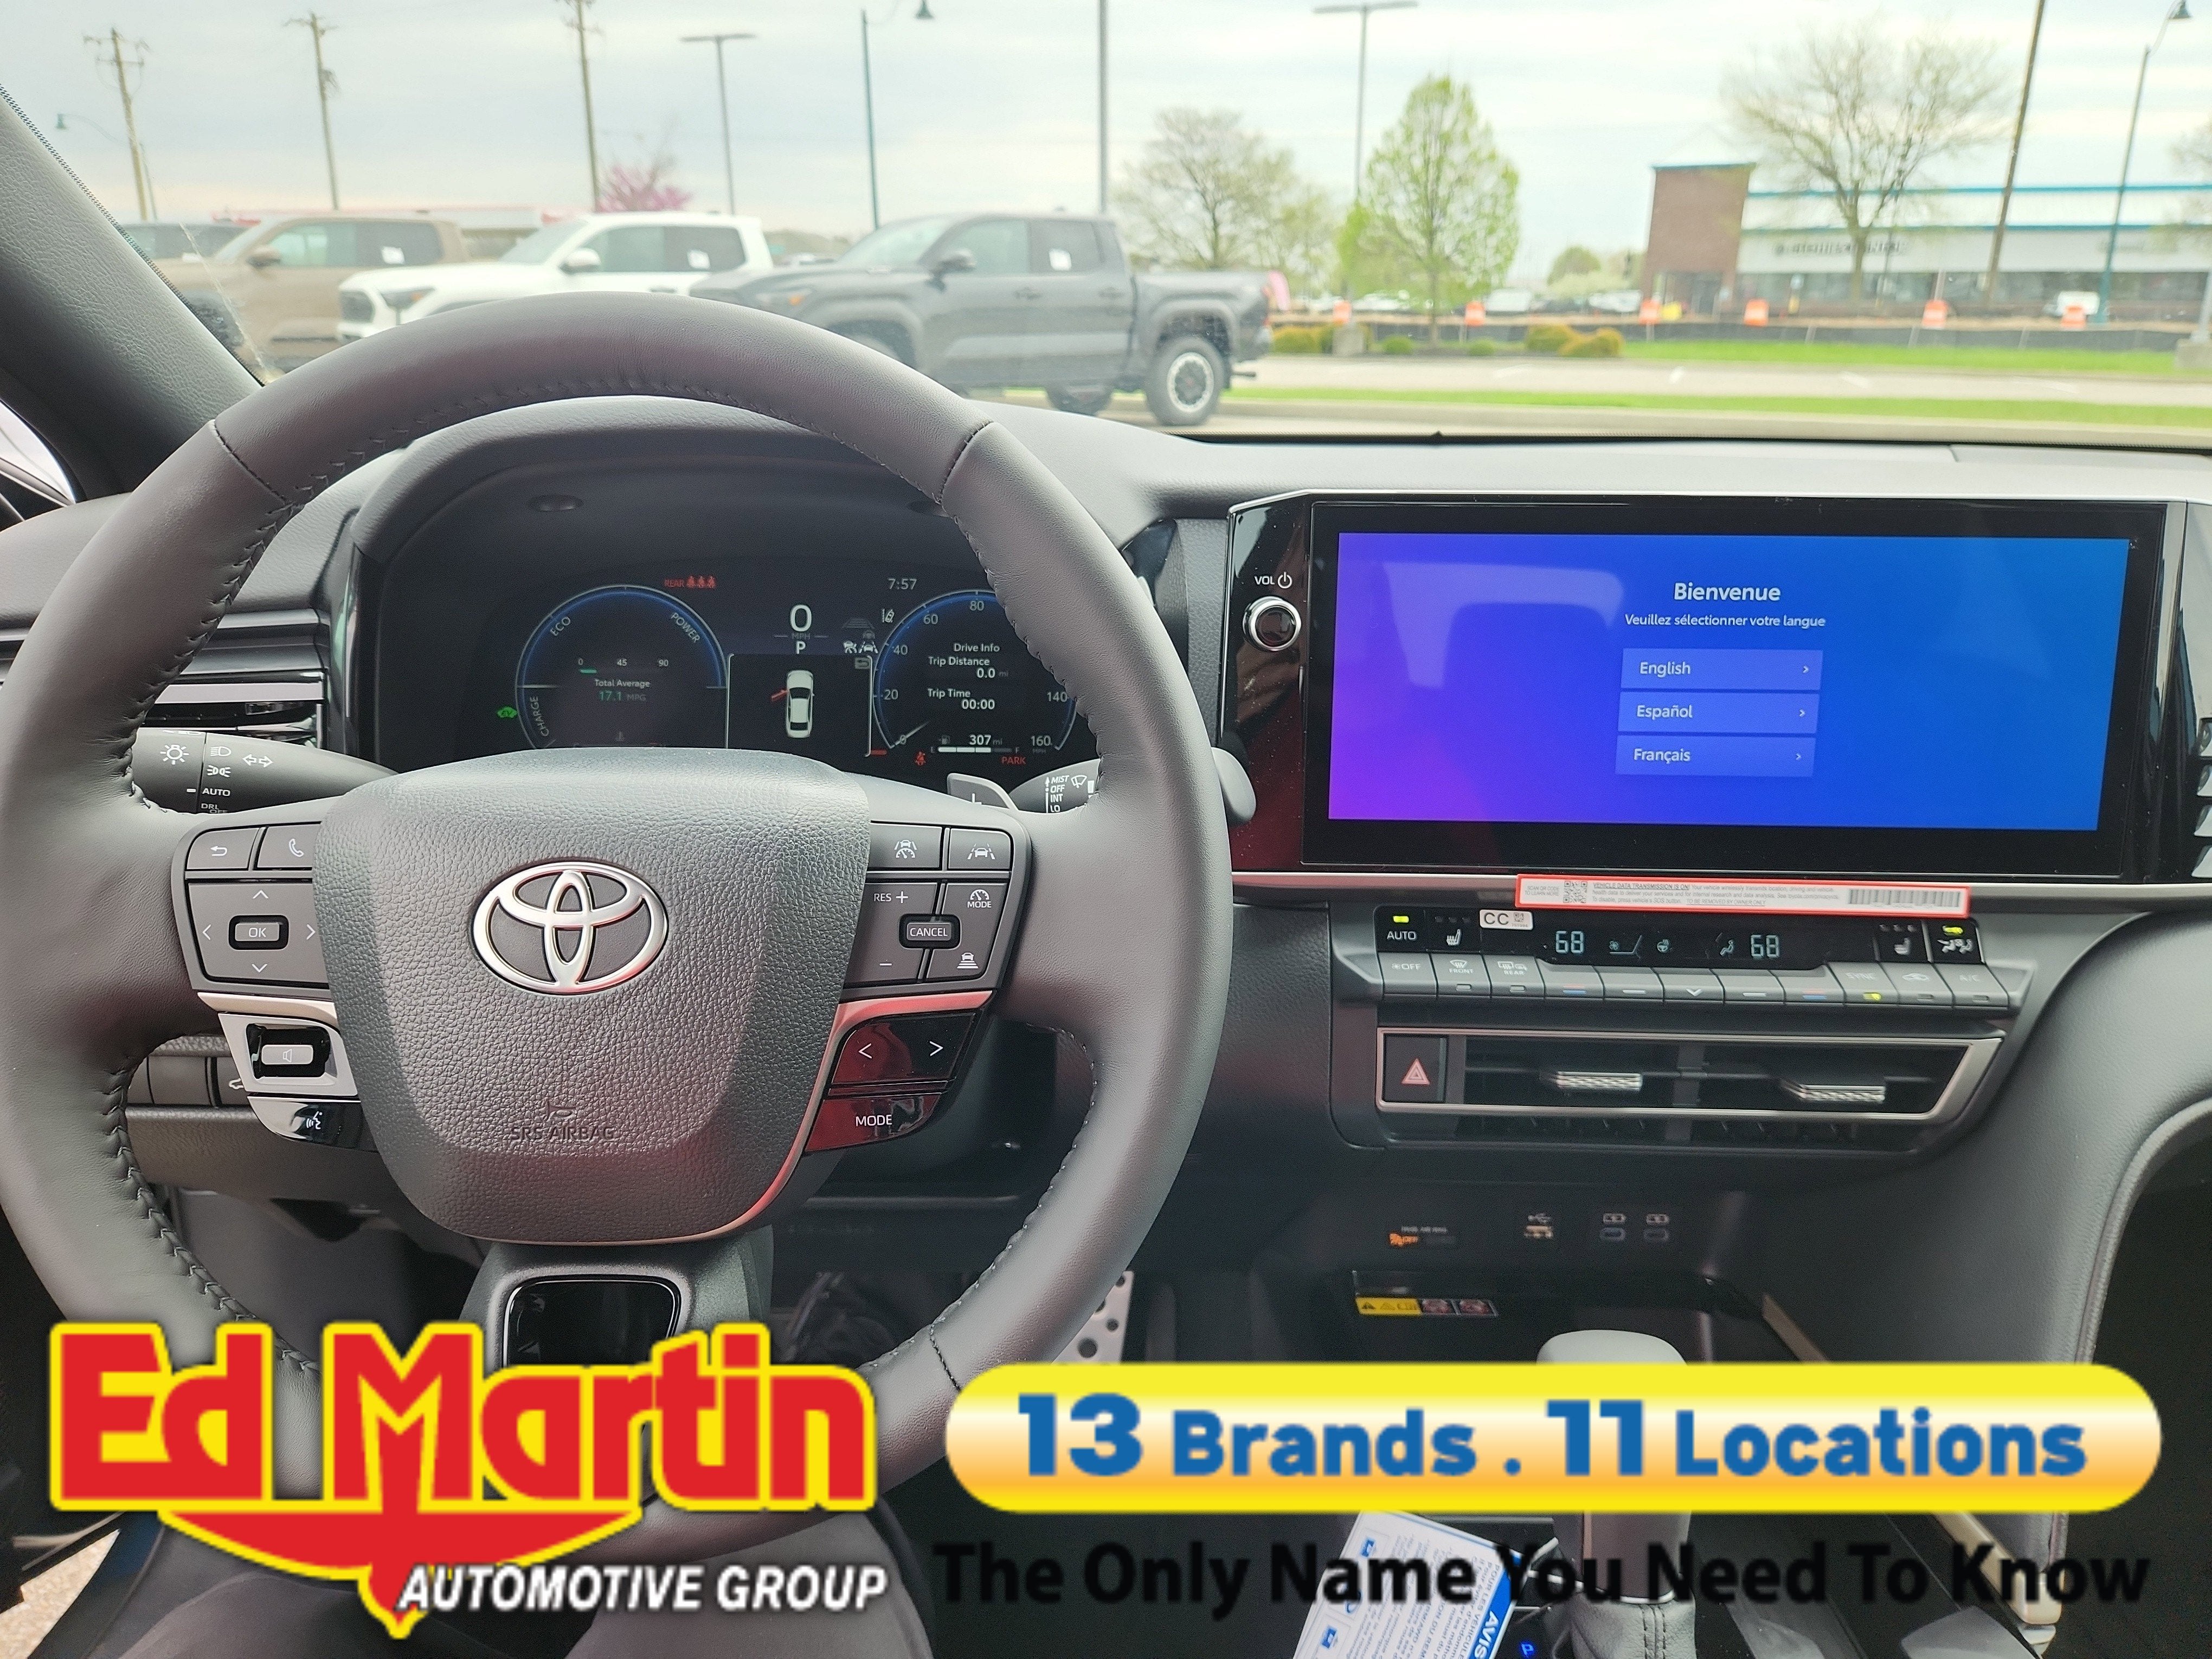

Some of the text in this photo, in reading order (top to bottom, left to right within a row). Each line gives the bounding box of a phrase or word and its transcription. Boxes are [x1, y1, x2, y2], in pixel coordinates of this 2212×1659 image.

[888, 578, 917, 590] 7:57
[1254, 576, 1275, 585] VOL
[1674, 582, 1781, 601] Bienvenue
[970, 600, 984, 611] 80
[790, 604, 812, 632] 0
[923, 613, 938, 625] 60
[1625, 614, 1825, 629] Veuillez sélectionner votre langue
[551, 616, 571, 636] ECO
[670, 612, 700, 644] POWER
[795, 641, 806, 654] P
[893, 644, 908, 655] 40
[954, 642, 1000, 652] Drive Info
[578, 658, 669, 667] 0 45 90
[928, 657, 989, 667] Trip Distance
[976, 667, 995, 679] 0.0
[1639, 661, 1691, 678] English
[595, 679, 650, 689] Total Average
[599, 691, 646, 702] 17.1 MPG
[884, 689, 898, 700] 20
[928, 688, 970, 698] Trip Time
[1046, 691, 1067, 702] 140
[961, 699, 995, 710] 00:00
[530, 696, 550, 737] CHARGE
[1637, 704, 1693, 721] Español
[969, 735, 991, 745] 307
[1031, 735, 1051, 746] 160
[1001, 756, 1026, 764] PARK
[1634, 748, 1690, 764] Français
[1051, 775, 1069, 784] MIST
[202, 788, 230, 796] AUTO
[1050, 785, 1065, 793] OFF
[1050, 793, 1063, 803] INT
[1050, 805, 1060, 813] LO
[874, 893, 891, 902] RES
[1484, 912, 1509, 925] CC
[248, 927, 266, 938] OK
[910, 928, 948, 937] CANCEL
[1386, 930, 1417, 941] AUTO
[1555, 930, 1585, 954] 68
[1751, 934, 1780, 959] 68
[856, 1115, 892, 1127] MODE
[513, 1126, 616, 1142] SRS AIRBAG
[1485, 1564, 1500, 1591] POUR
[1477, 1592, 1489, 1611] LES
[1471, 1611, 1502, 1659] AVIS
[1521, 1642, 1534, 1657] P
